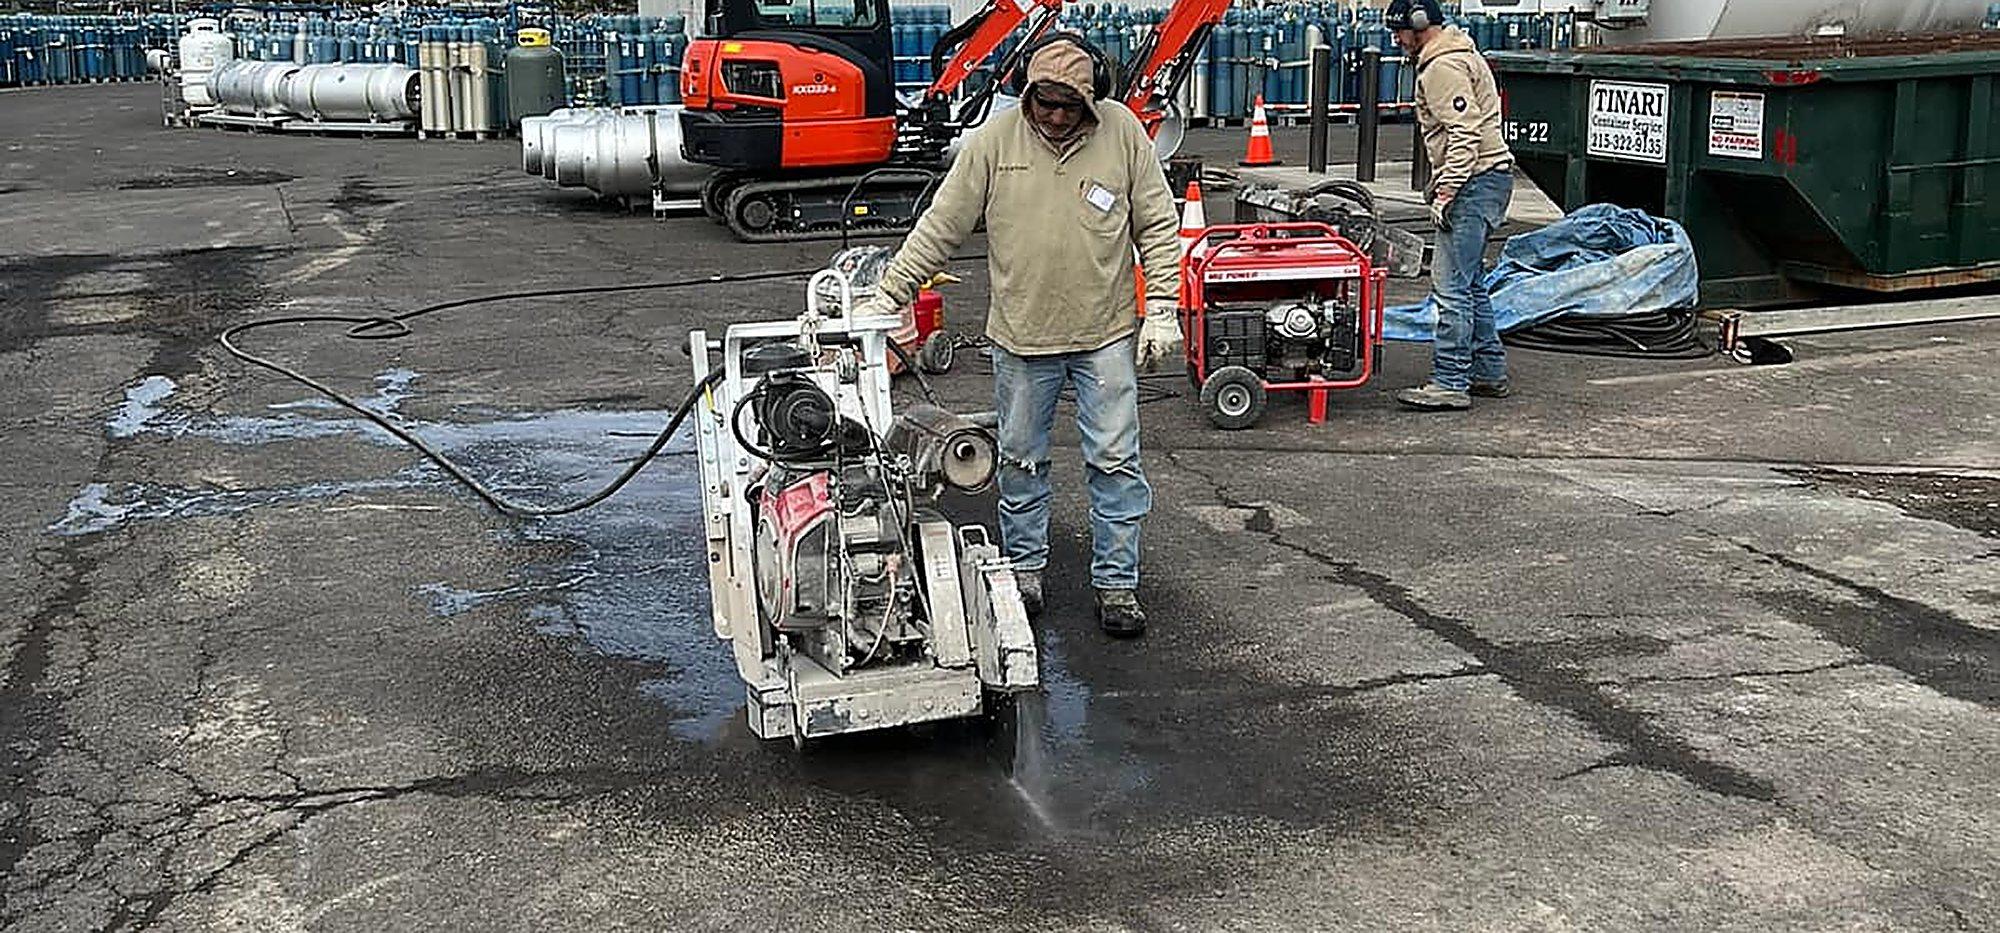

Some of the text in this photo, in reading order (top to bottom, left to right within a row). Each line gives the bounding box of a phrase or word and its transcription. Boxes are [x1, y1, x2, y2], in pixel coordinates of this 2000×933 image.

[1595, 88, 1664, 117] TINARI
[1592, 114, 1663, 133] Container Service
[1592, 133, 1661, 154] 215-322-9135
